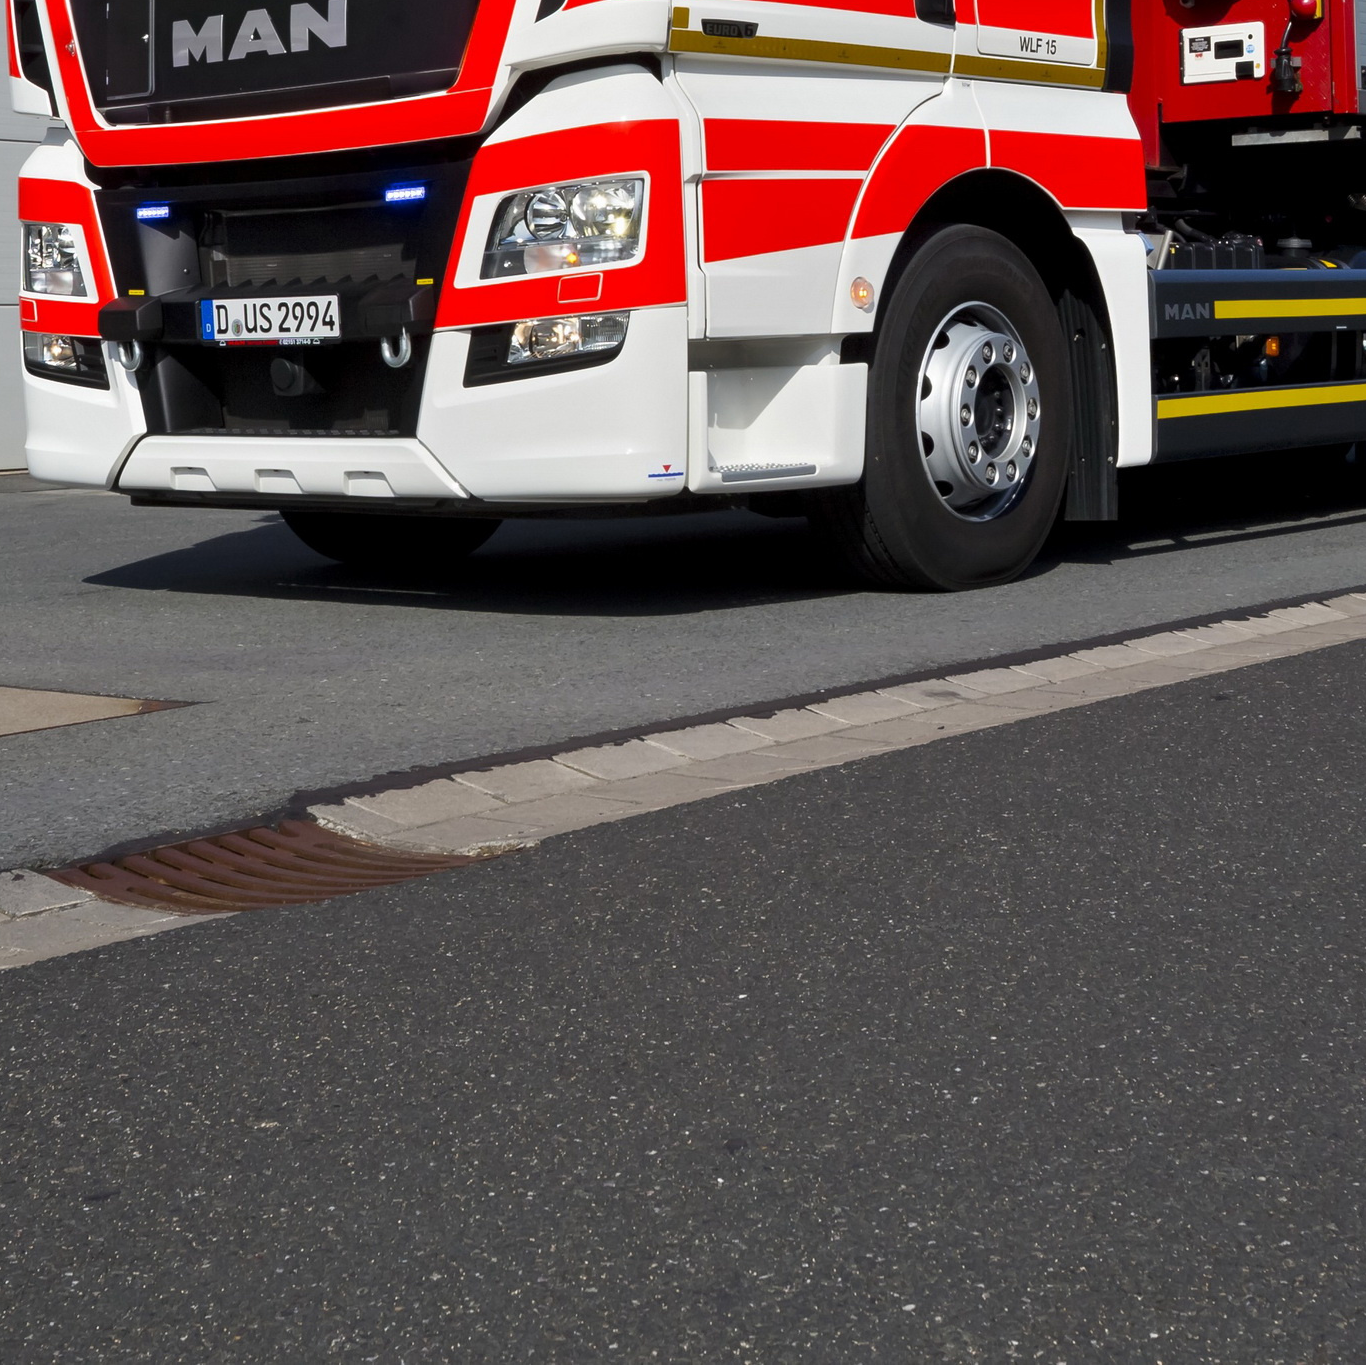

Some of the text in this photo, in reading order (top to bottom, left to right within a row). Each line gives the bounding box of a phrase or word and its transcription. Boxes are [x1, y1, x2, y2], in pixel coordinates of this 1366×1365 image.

[706, 23, 739, 36] EURO
[1019, 35, 1057, 55] WLF 15
[215, 300, 336, 335] D US 2994
[1164, 302, 1210, 321] MAN
[206, 323, 212, 333] D
